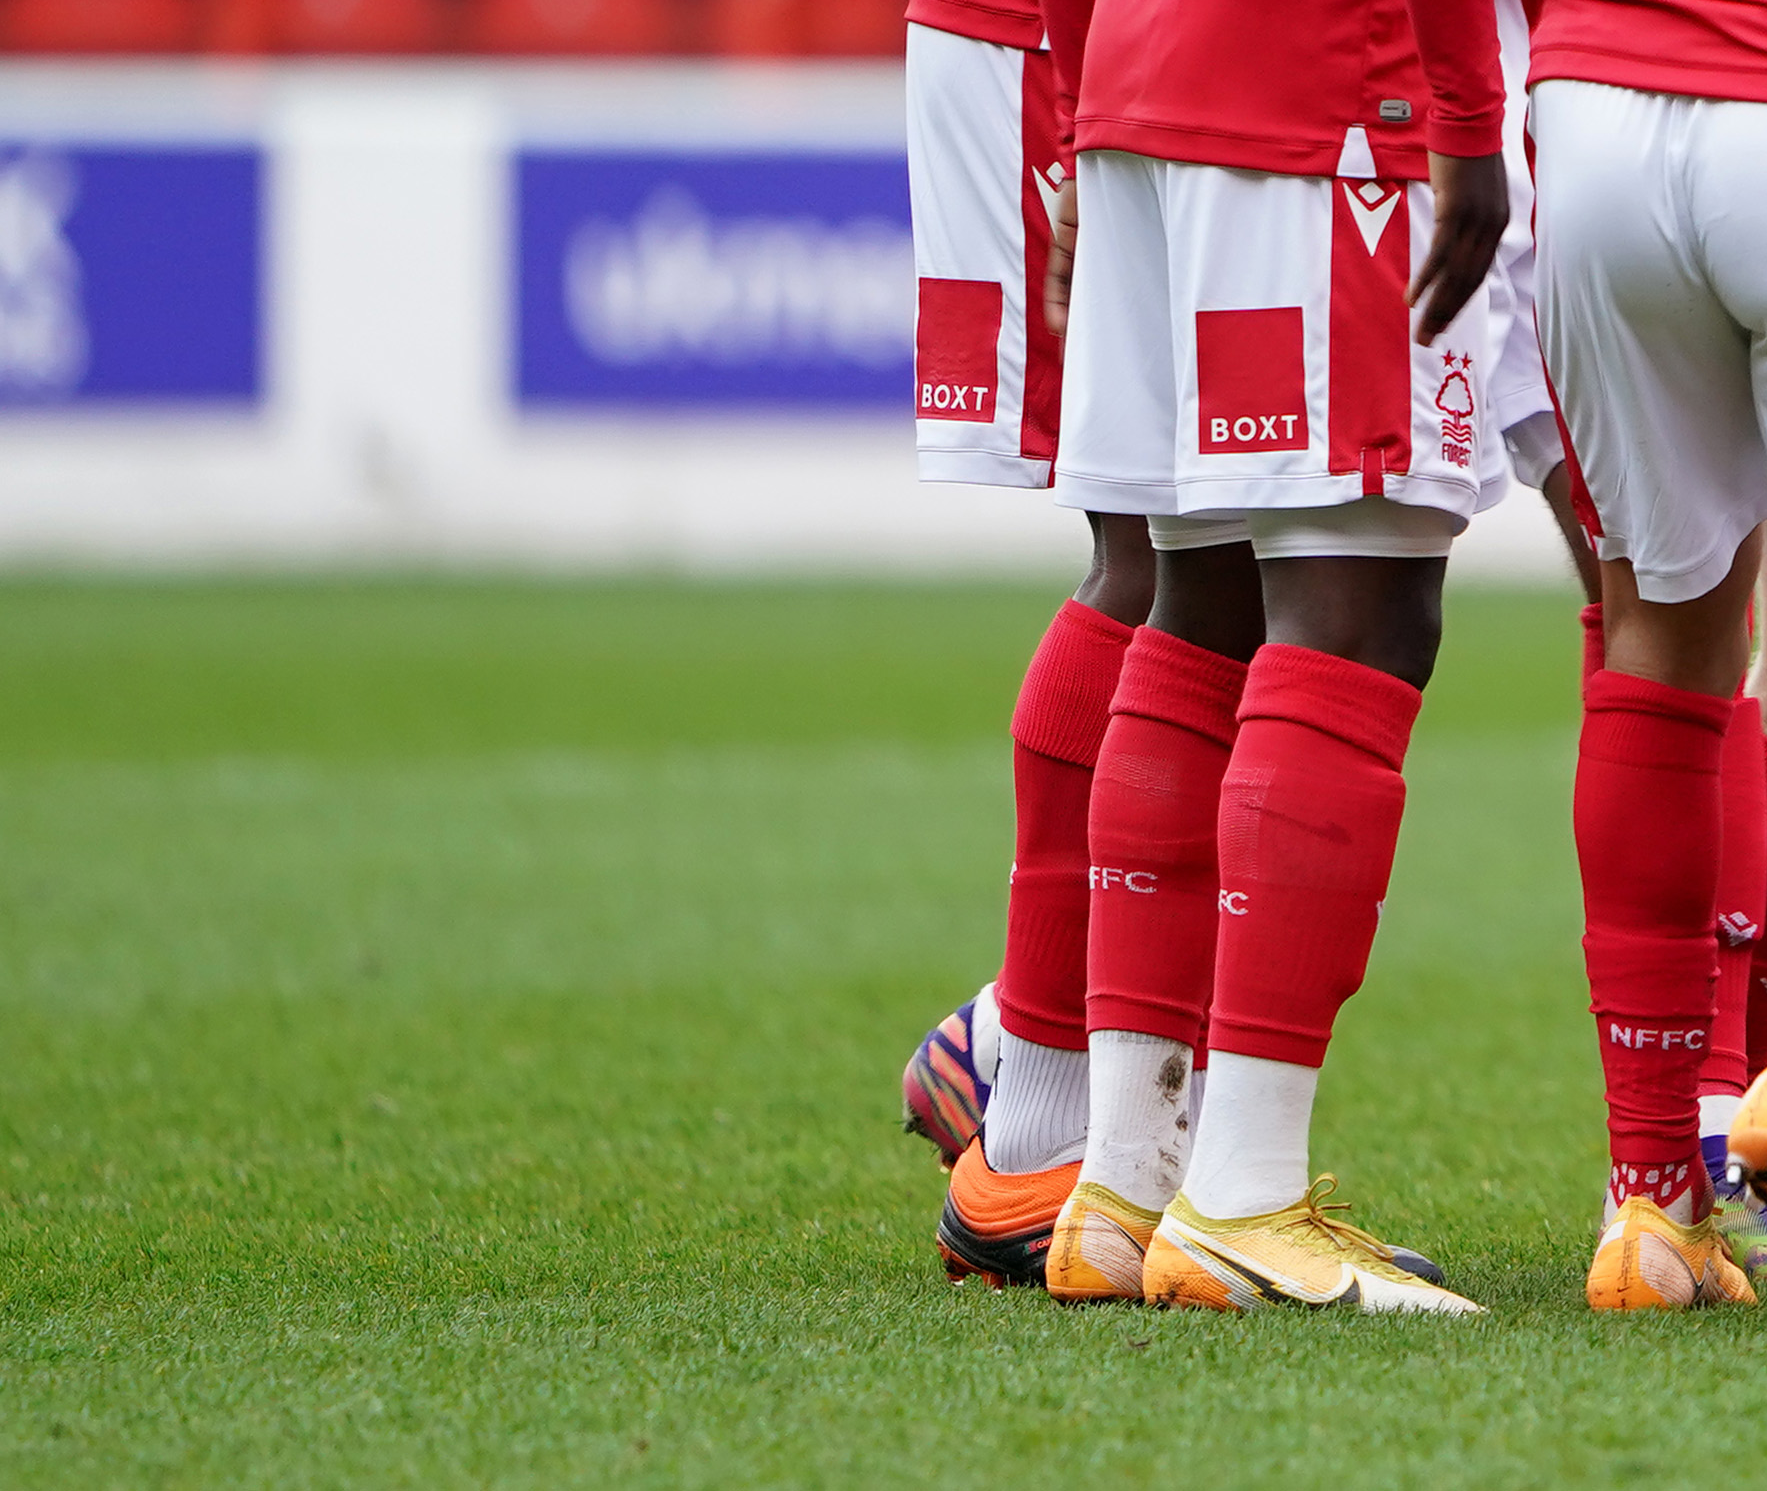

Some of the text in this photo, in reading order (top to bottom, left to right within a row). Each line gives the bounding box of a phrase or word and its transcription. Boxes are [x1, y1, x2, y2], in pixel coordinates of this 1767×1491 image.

[921, 382, 988, 412] BOXT
[1210, 414, 1299, 444] BOXT
[1610, 1022, 1705, 1051] NFFC
